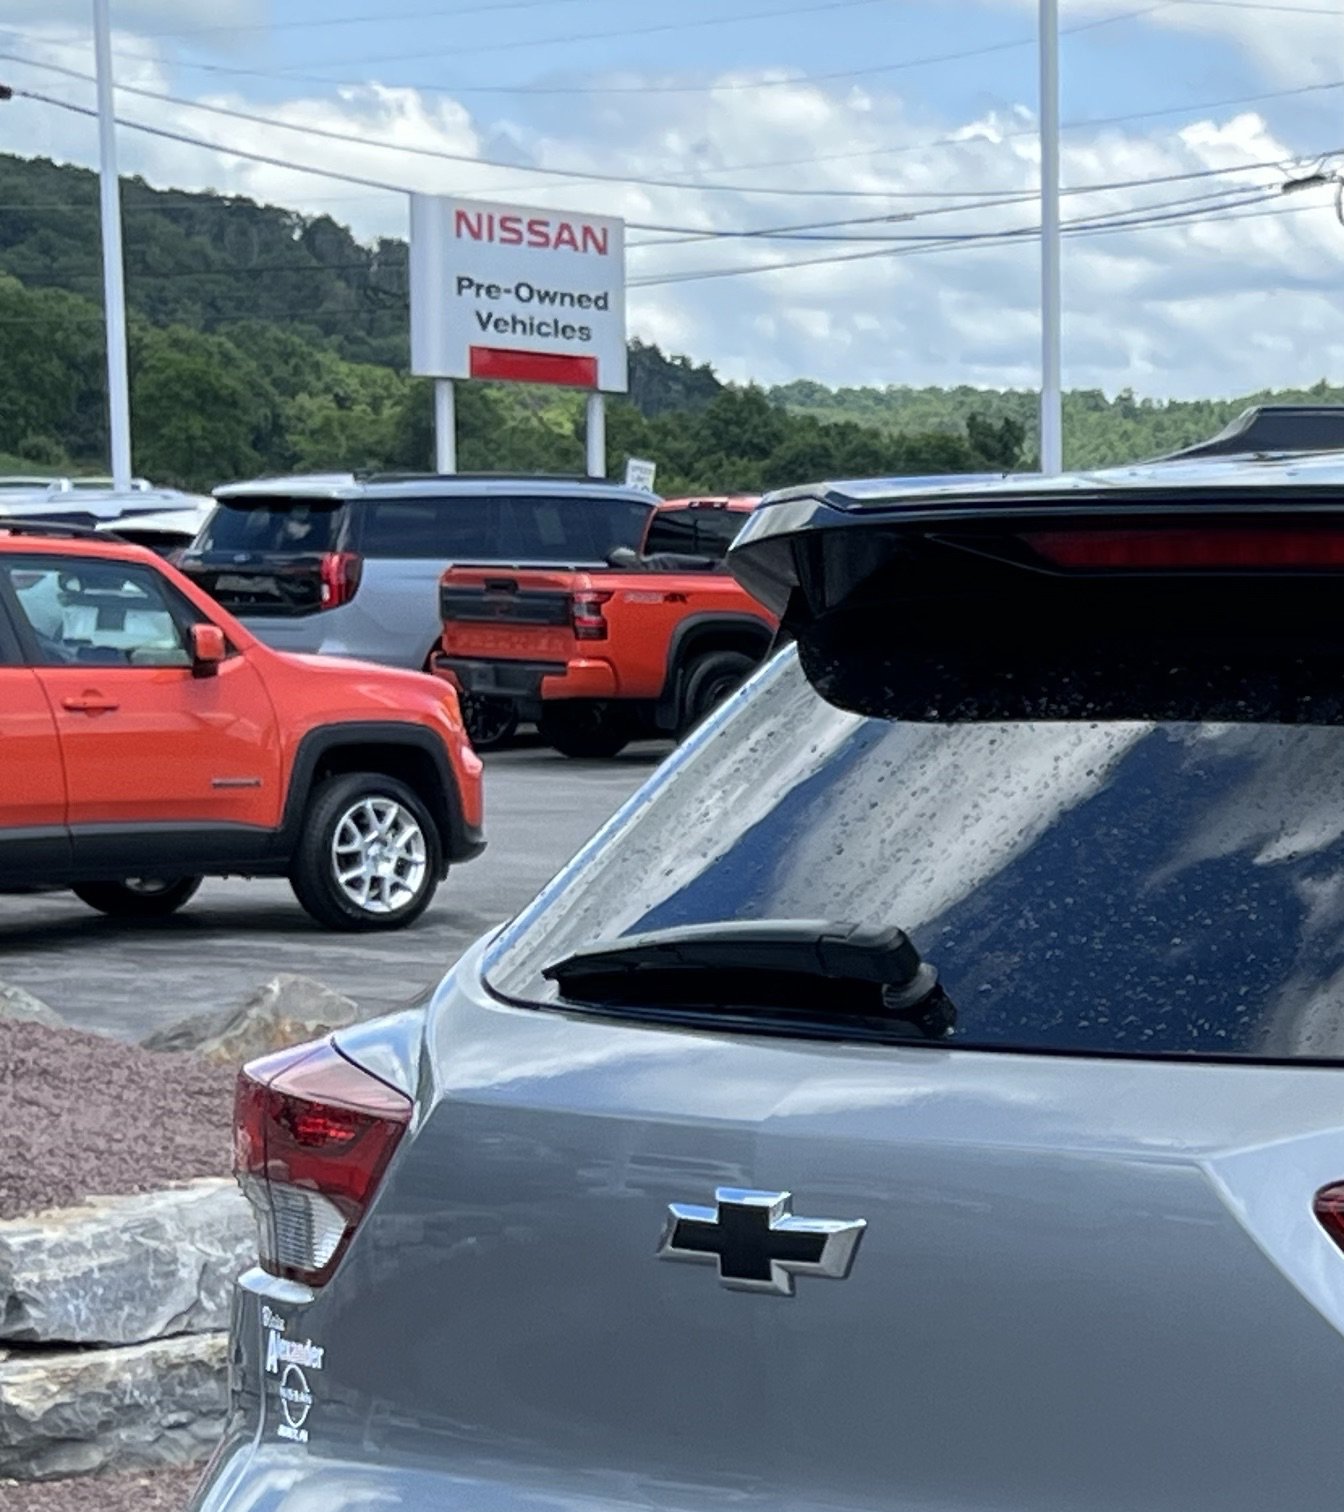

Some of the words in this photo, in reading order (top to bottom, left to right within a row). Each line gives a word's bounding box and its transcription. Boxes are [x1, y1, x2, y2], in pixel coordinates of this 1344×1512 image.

[455, 209, 609, 256] NISSAN
[456, 275, 610, 312] Pre-Owned
[475, 310, 593, 342] Vehicles
